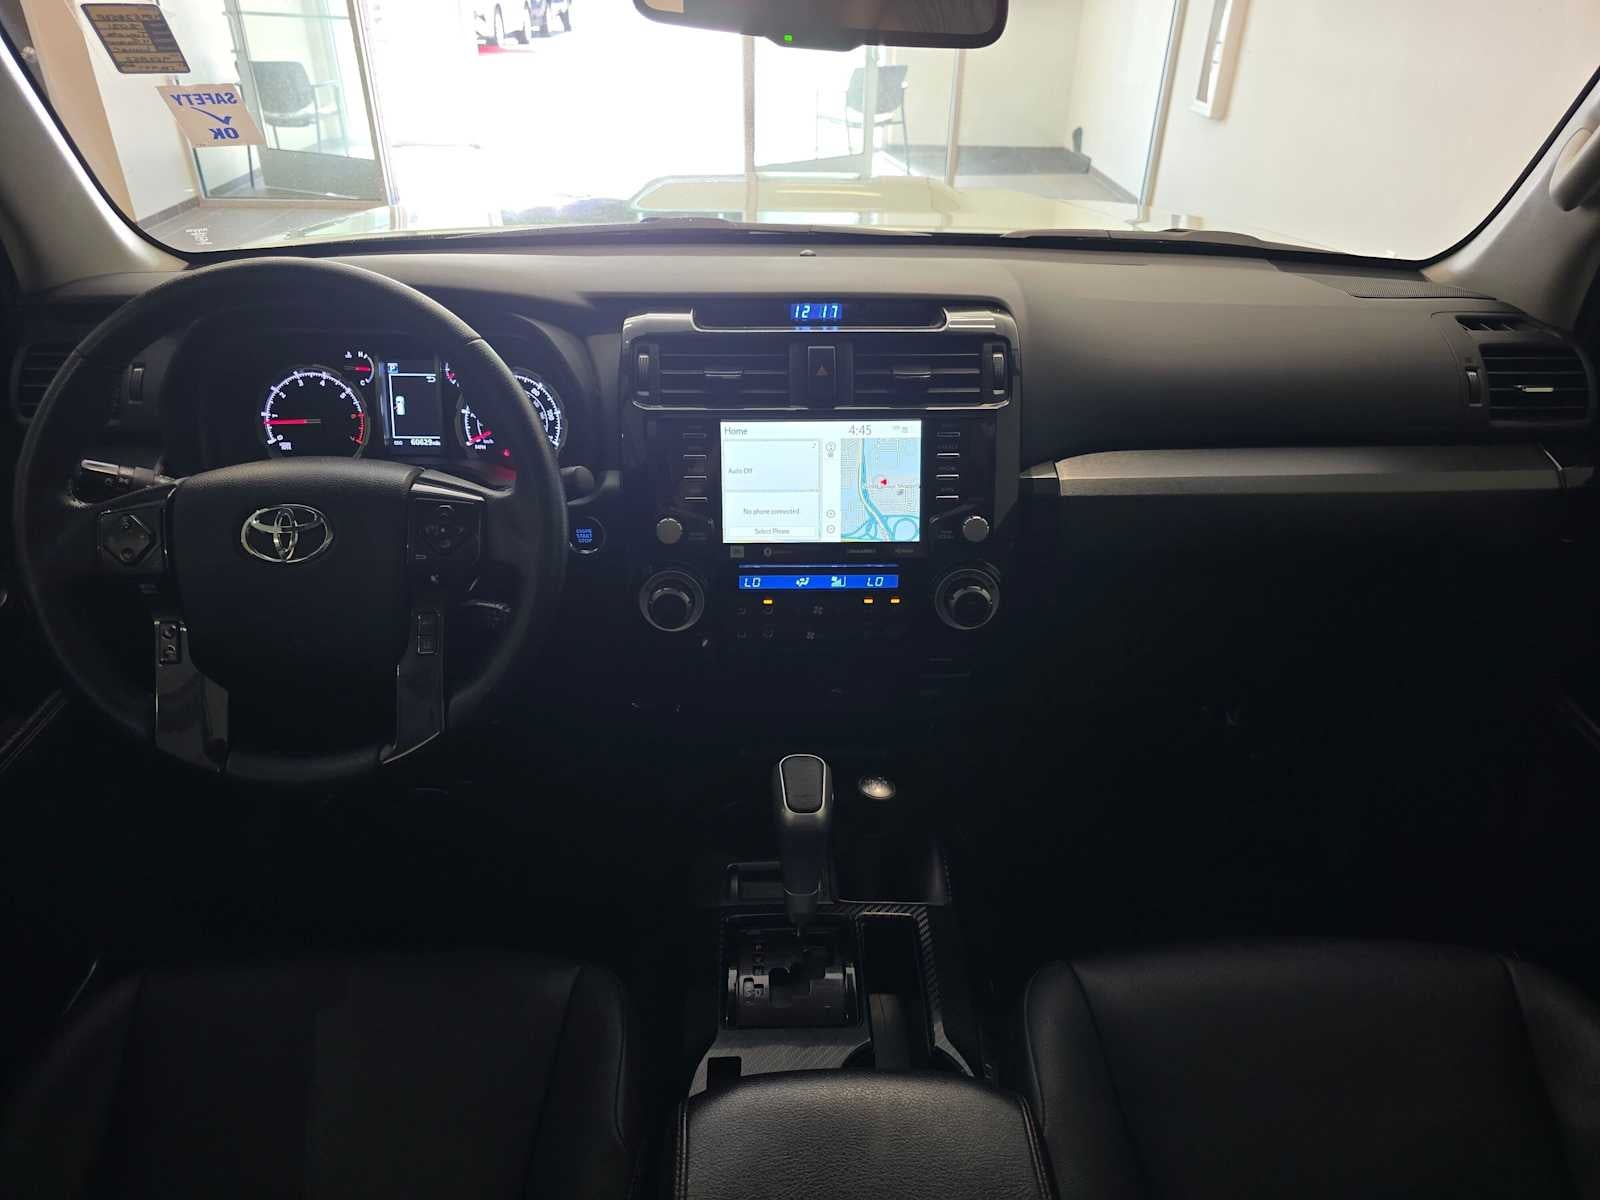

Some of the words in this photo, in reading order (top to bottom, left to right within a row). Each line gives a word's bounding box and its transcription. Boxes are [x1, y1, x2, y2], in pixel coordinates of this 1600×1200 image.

[319, 379, 326, 387] 4
[279, 391, 287, 399] 2
[723, 427, 749, 436] Home
[847, 424, 872, 436] 4:45
[752, 508, 771, 516] phone
[743, 577, 761, 588] LO
[866, 576, 884, 587] LO
